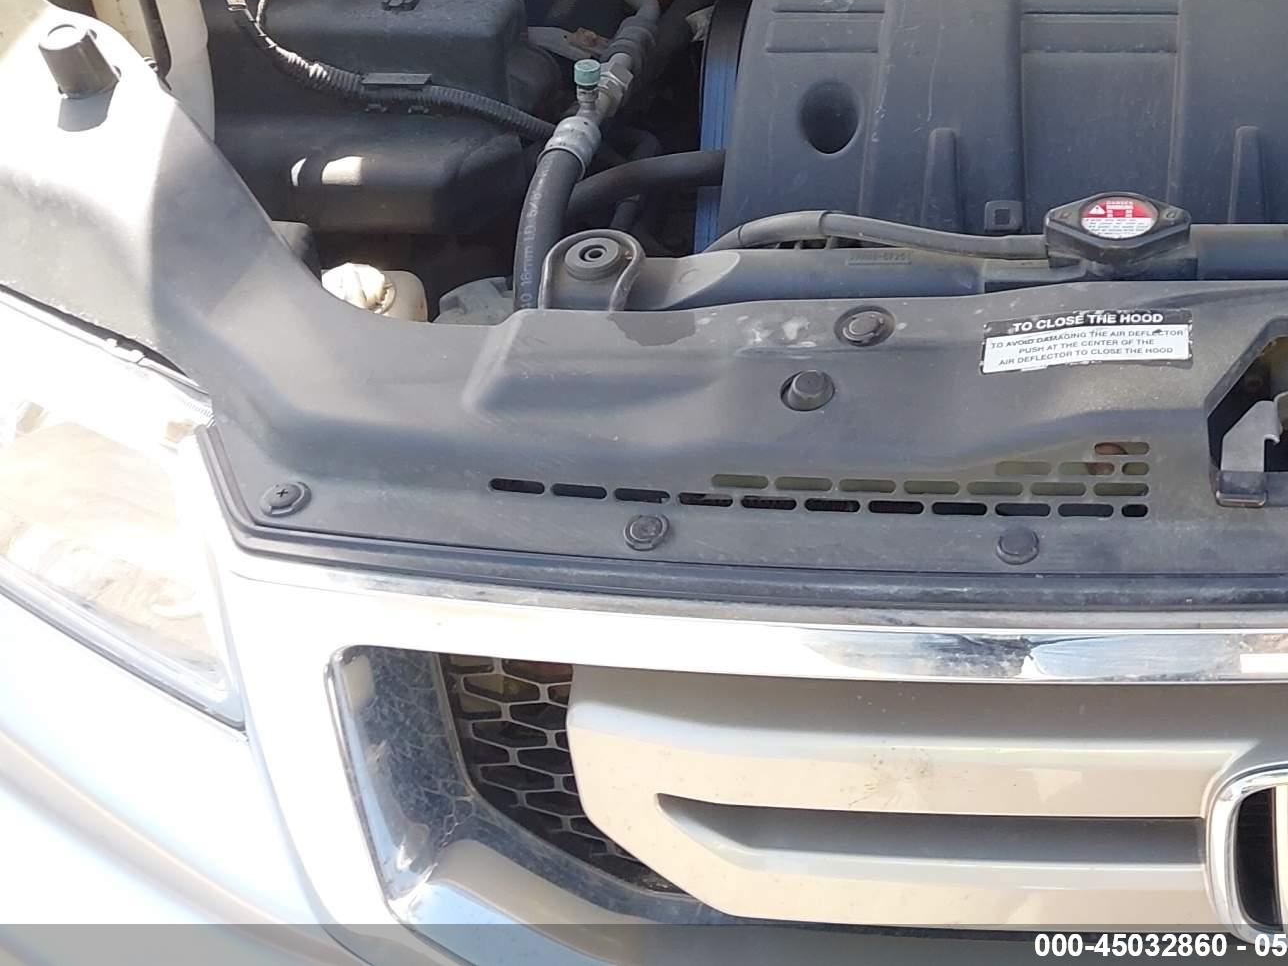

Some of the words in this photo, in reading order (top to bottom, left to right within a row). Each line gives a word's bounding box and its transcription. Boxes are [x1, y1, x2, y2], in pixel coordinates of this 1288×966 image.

[1013, 322, 1033, 332] TO
[1036, 314, 1084, 330] CLOSE
[1087, 313, 1117, 325] THE
[1119, 313, 1164, 324] HOOD
[1036, 332, 1087, 344] DAMAGING
[1089, 330, 1107, 338] THE
[1018, 346, 1045, 354] PUSH
[1046, 344, 1058, 352] AT
[1081, 339, 1118, 347] CENTER
[998, 358, 1015, 366] AIR
[1017, 352, 1073, 364] DEFLECTOR
[1075, 349, 1088, 357] TO
[1145, 346, 1173, 354] HOOD
